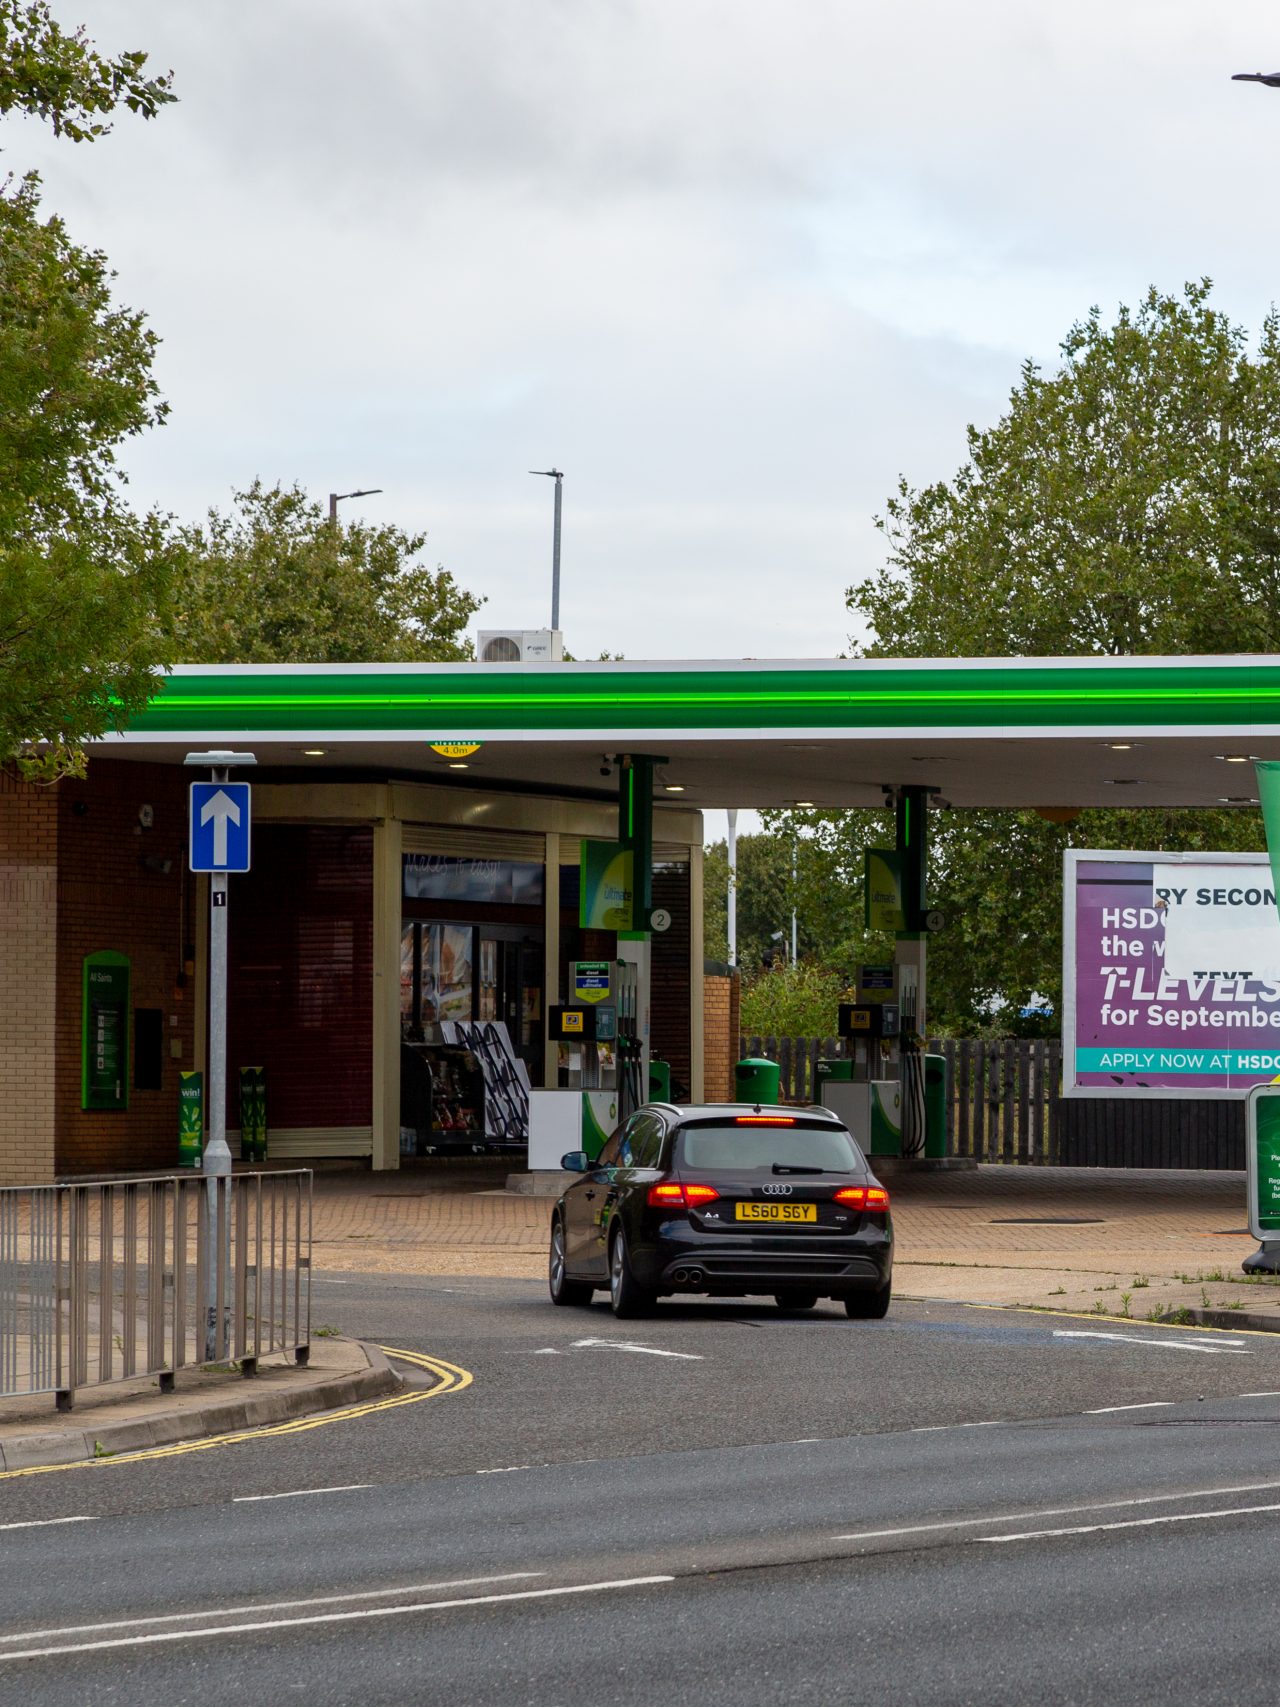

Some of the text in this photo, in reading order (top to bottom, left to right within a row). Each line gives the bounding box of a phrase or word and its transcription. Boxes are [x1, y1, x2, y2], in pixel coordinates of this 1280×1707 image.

[216, 893, 223, 905] 1
[656, 914, 665, 926] 2
[931, 915, 939, 926] 4
[1101, 935, 1144, 957] the
[1100, 1004, 1139, 1026] for
[1099, 1053, 1155, 1068] APPLY
[1160, 1053, 1205, 1069] NOW
[1210, 1054, 1232, 1069] AT
[181, 1088, 201, 1097] win!
[742, 1205, 811, 1219] LS60 SGY
